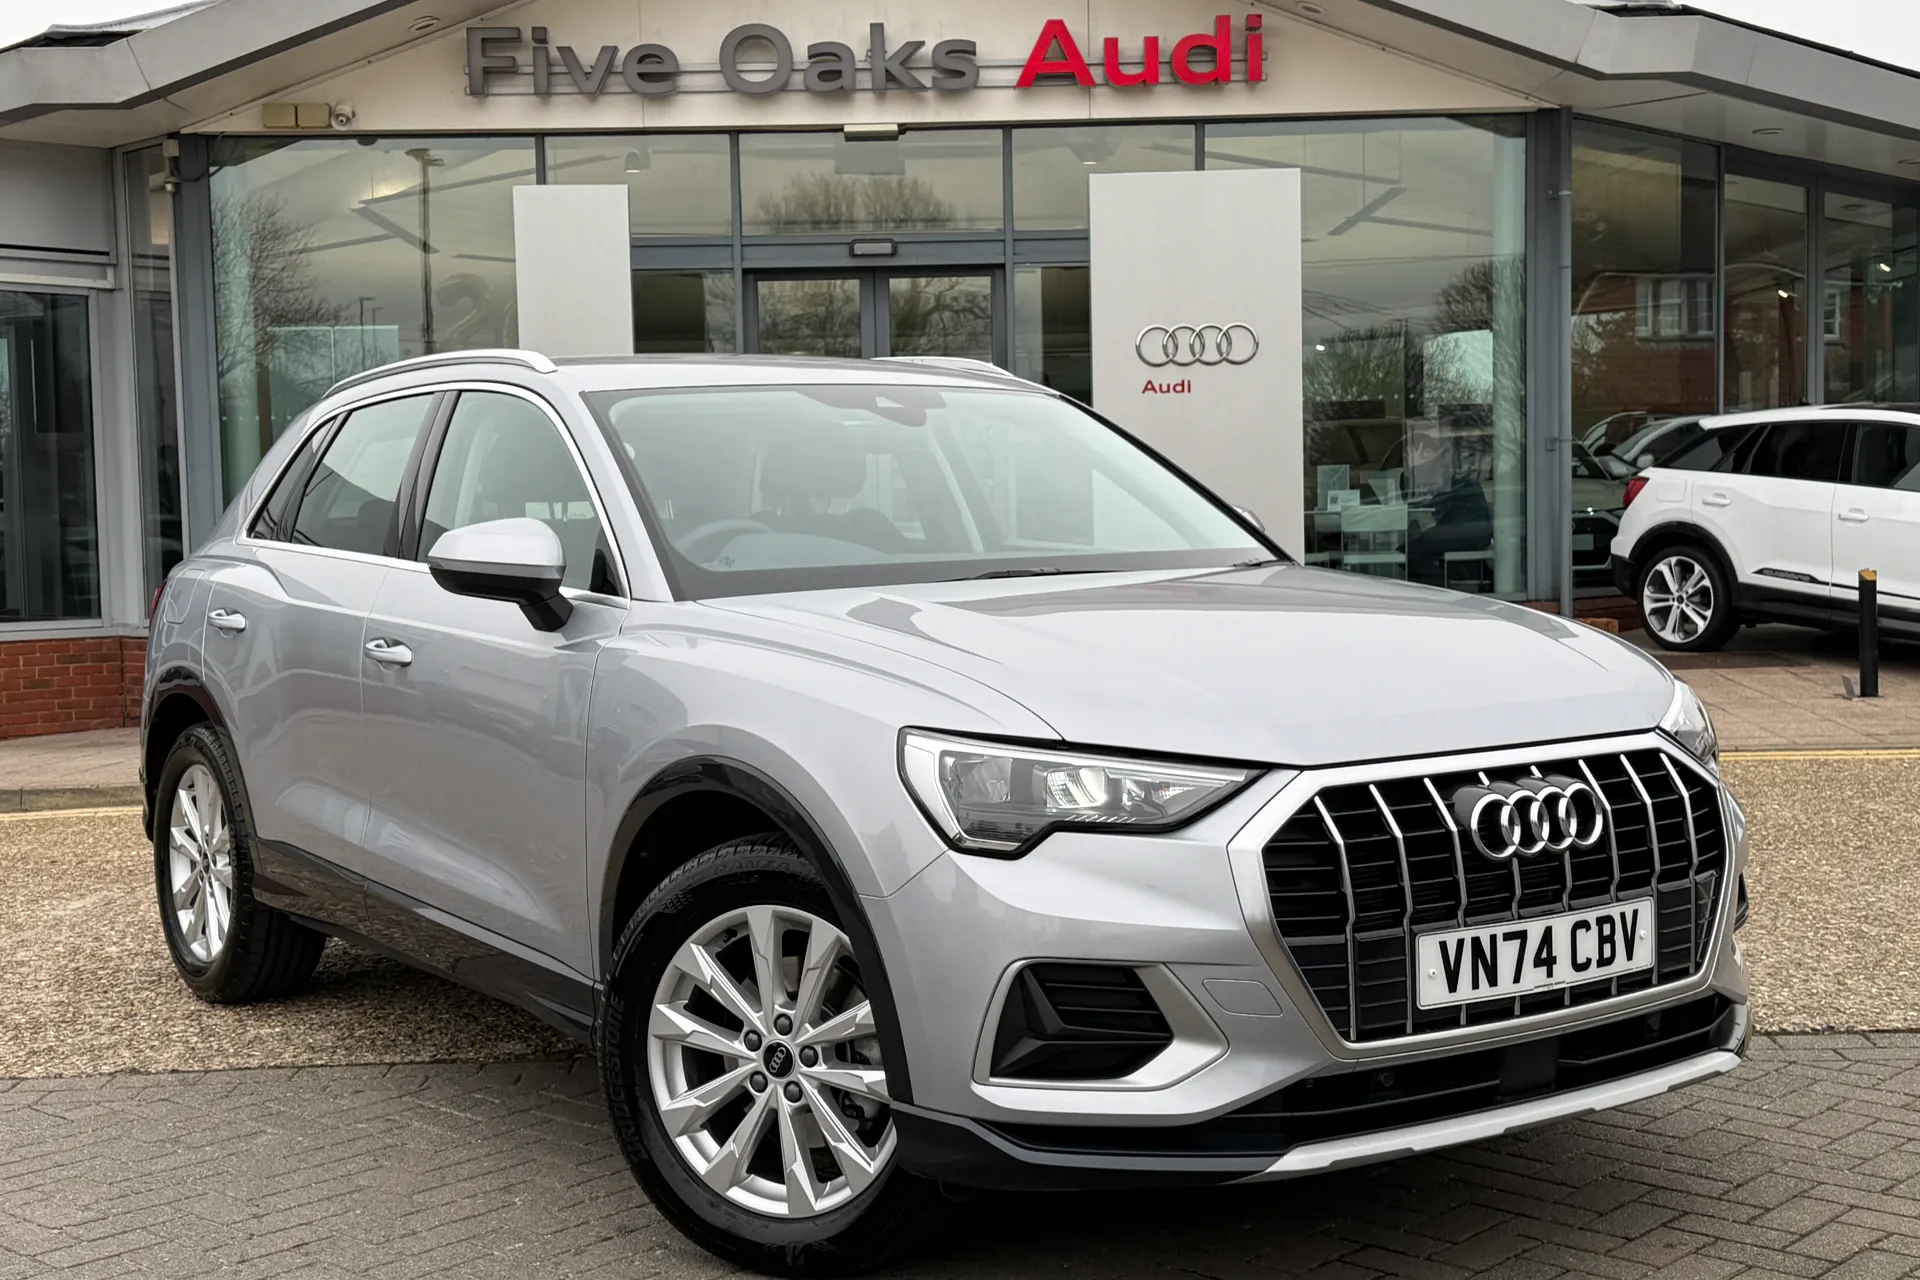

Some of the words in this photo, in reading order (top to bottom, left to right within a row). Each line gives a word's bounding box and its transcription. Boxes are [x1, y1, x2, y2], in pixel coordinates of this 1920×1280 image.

[466, 26, 680, 97] Five
[719, 22, 980, 95] Oaks
[1015, 14, 1263, 89] Audi
[1141, 379, 1192, 394] Audi
[1439, 925, 1557, 994] VN74
[1570, 909, 1639, 973] CBV
